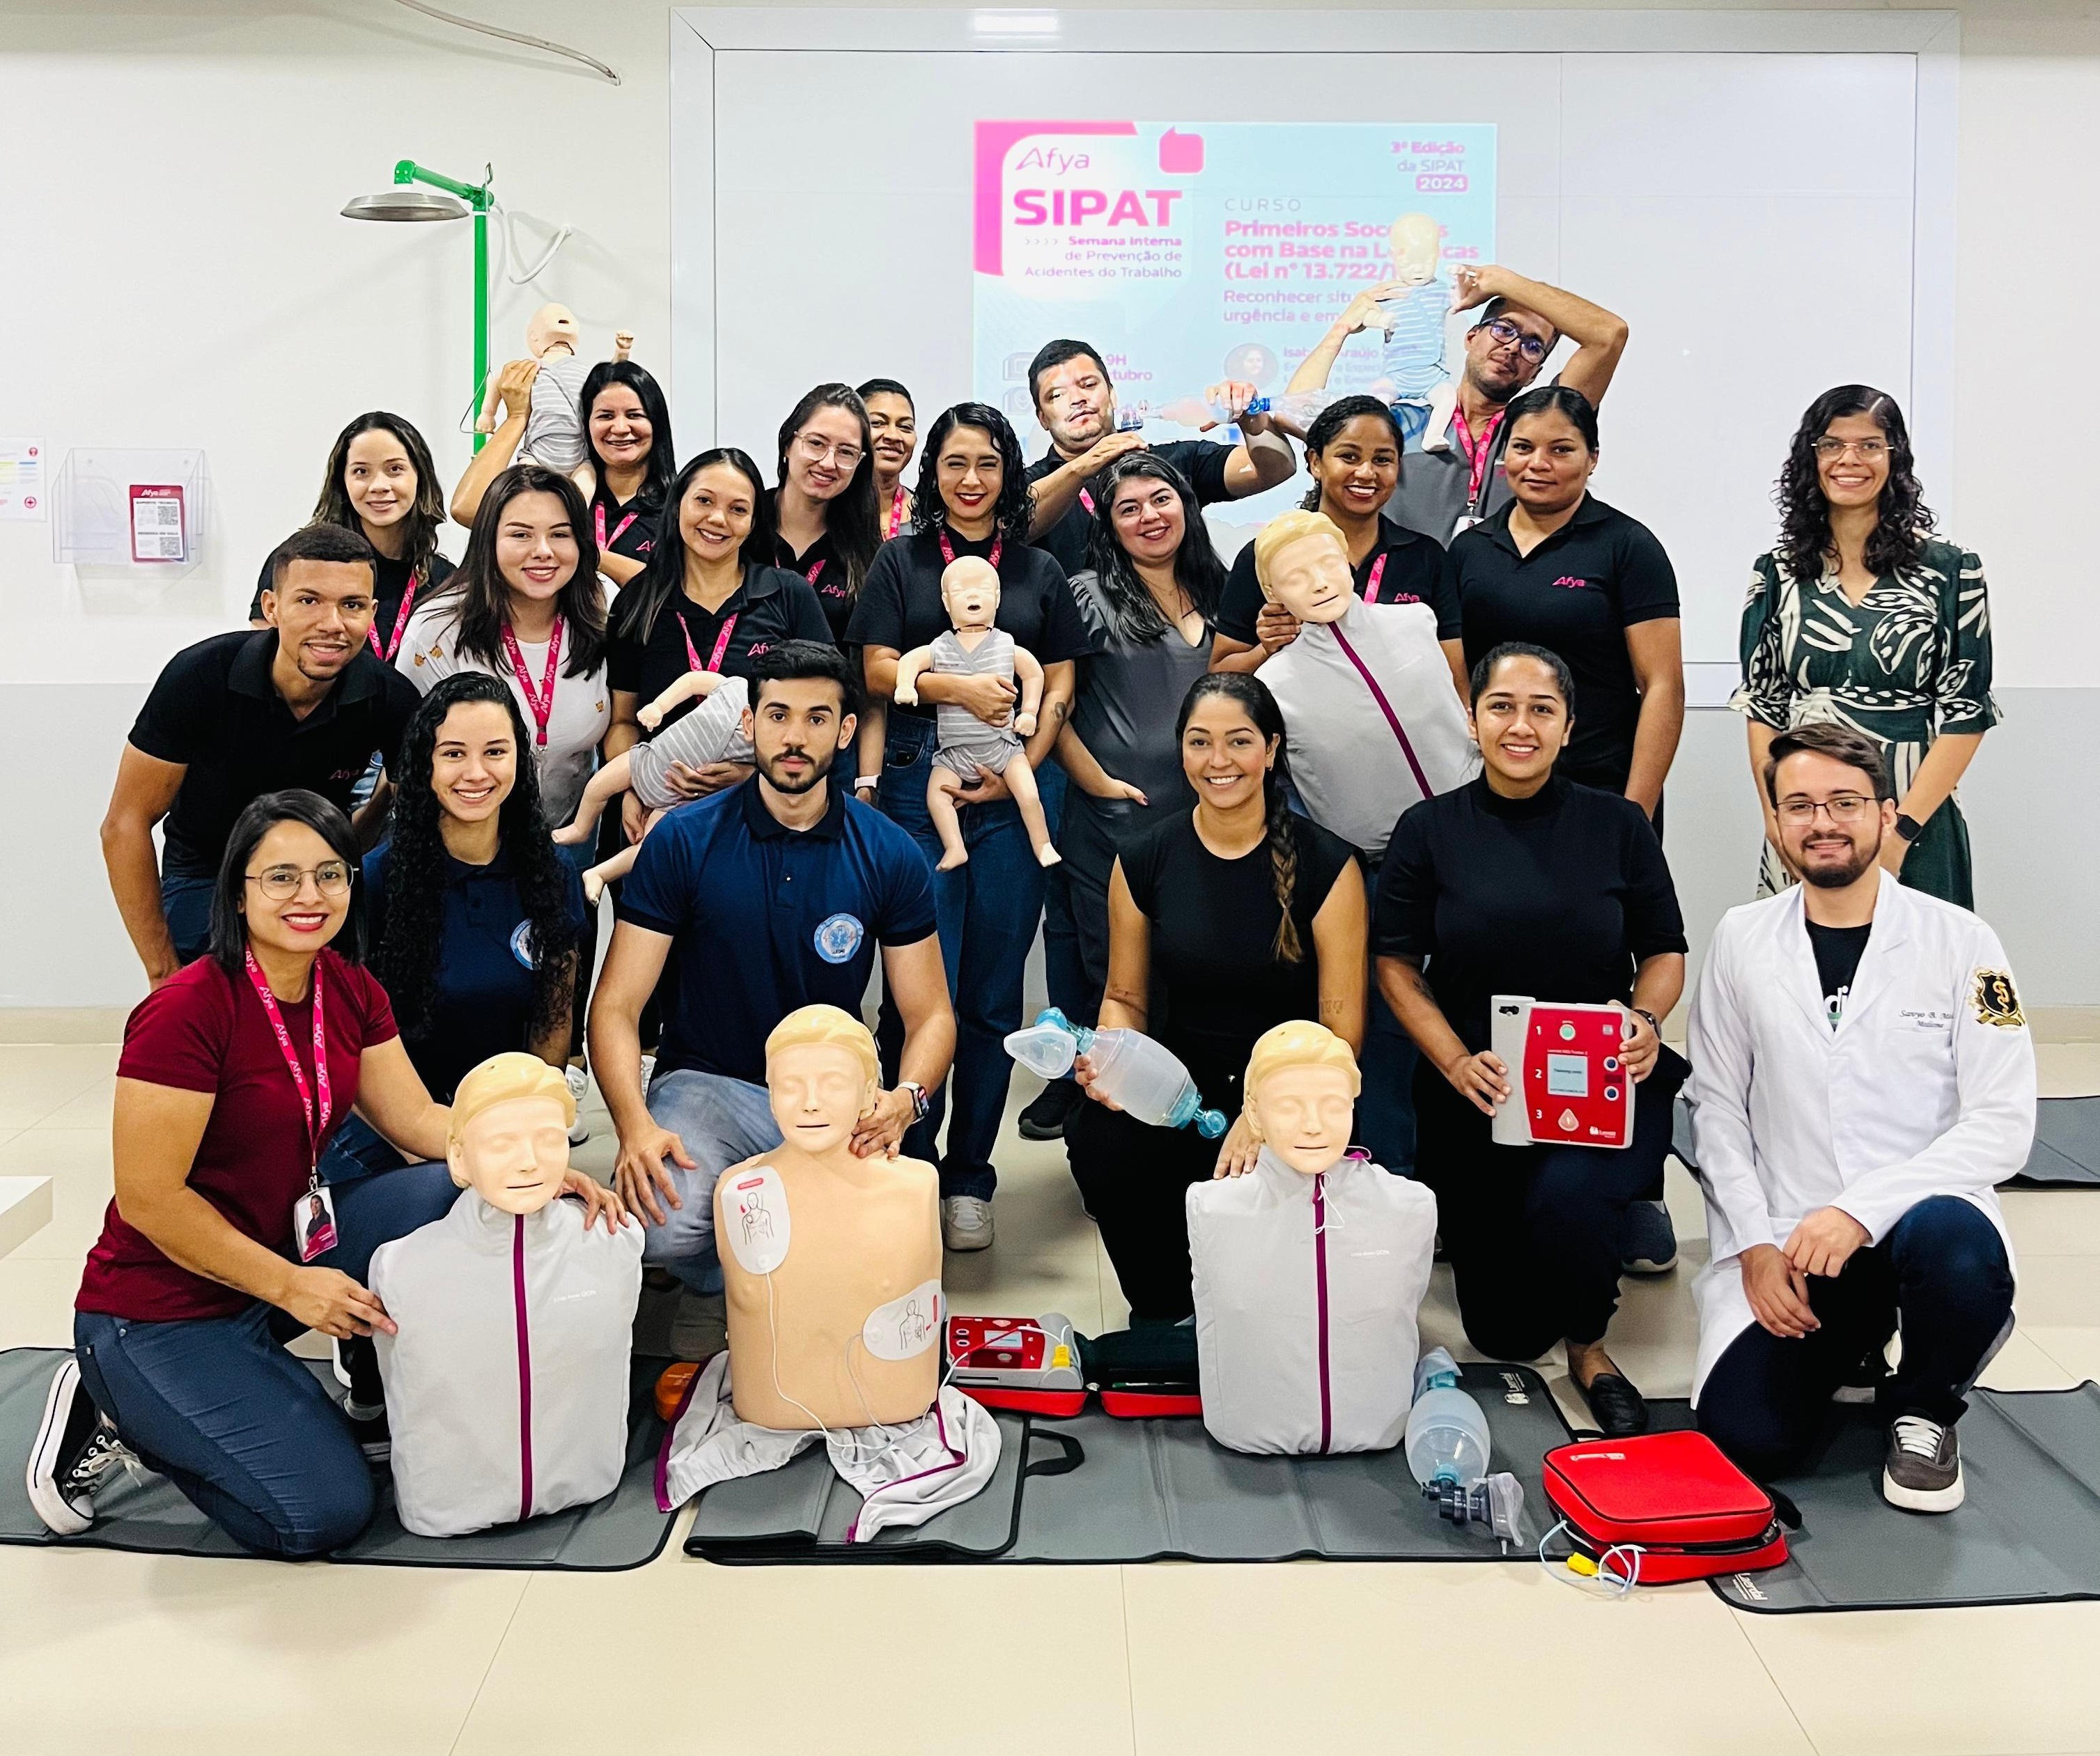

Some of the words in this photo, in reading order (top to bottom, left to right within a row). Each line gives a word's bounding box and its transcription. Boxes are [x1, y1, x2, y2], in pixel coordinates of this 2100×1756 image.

[1411, 141, 1465, 156] Edição
[1014, 147, 1090, 176] Afya
[1397, 160, 1415, 172] da
[1421, 160, 1465, 172] SIPAT
[1420, 177, 1465, 189] 2024
[1013, 189, 1183, 227] SIPAT
[1224, 198, 1301, 212] CURSO
[1224, 219, 1339, 238] Primeiros
[1068, 235, 1126, 246] Semana
[1130, 235, 1183, 247] Interna
[1224, 244, 1274, 258] com
[1280, 241, 1334, 258] Base
[1339, 244, 1368, 258] na
[1065, 250, 1082, 261] de
[1086, 250, 1160, 264] Prevenção
[1165, 250, 1183, 261] de
[1025, 266, 1094, 278] Acidentes
[1098, 266, 1116, 278] do
[1121, 266, 1183, 278] Trabalho
[1224, 261, 1269, 280] (Lei
[1224, 290, 1323, 304] Reconhecer
[1224, 309, 1295, 325] urgência
[1301, 311, 1310, 322] e
[1552, 576, 1587, 589] Afya
[258, 986, 274, 1010] Afya
[274, 1023, 289, 1047] Afya
[1536, 1025, 1541, 1035] 1
[290, 1059, 303, 1084] Afya
[1535, 1069, 1542, 1079] 2
[1536, 1109, 1543, 1119] 3
[1737, 1572, 1768, 1600] Laerdal
